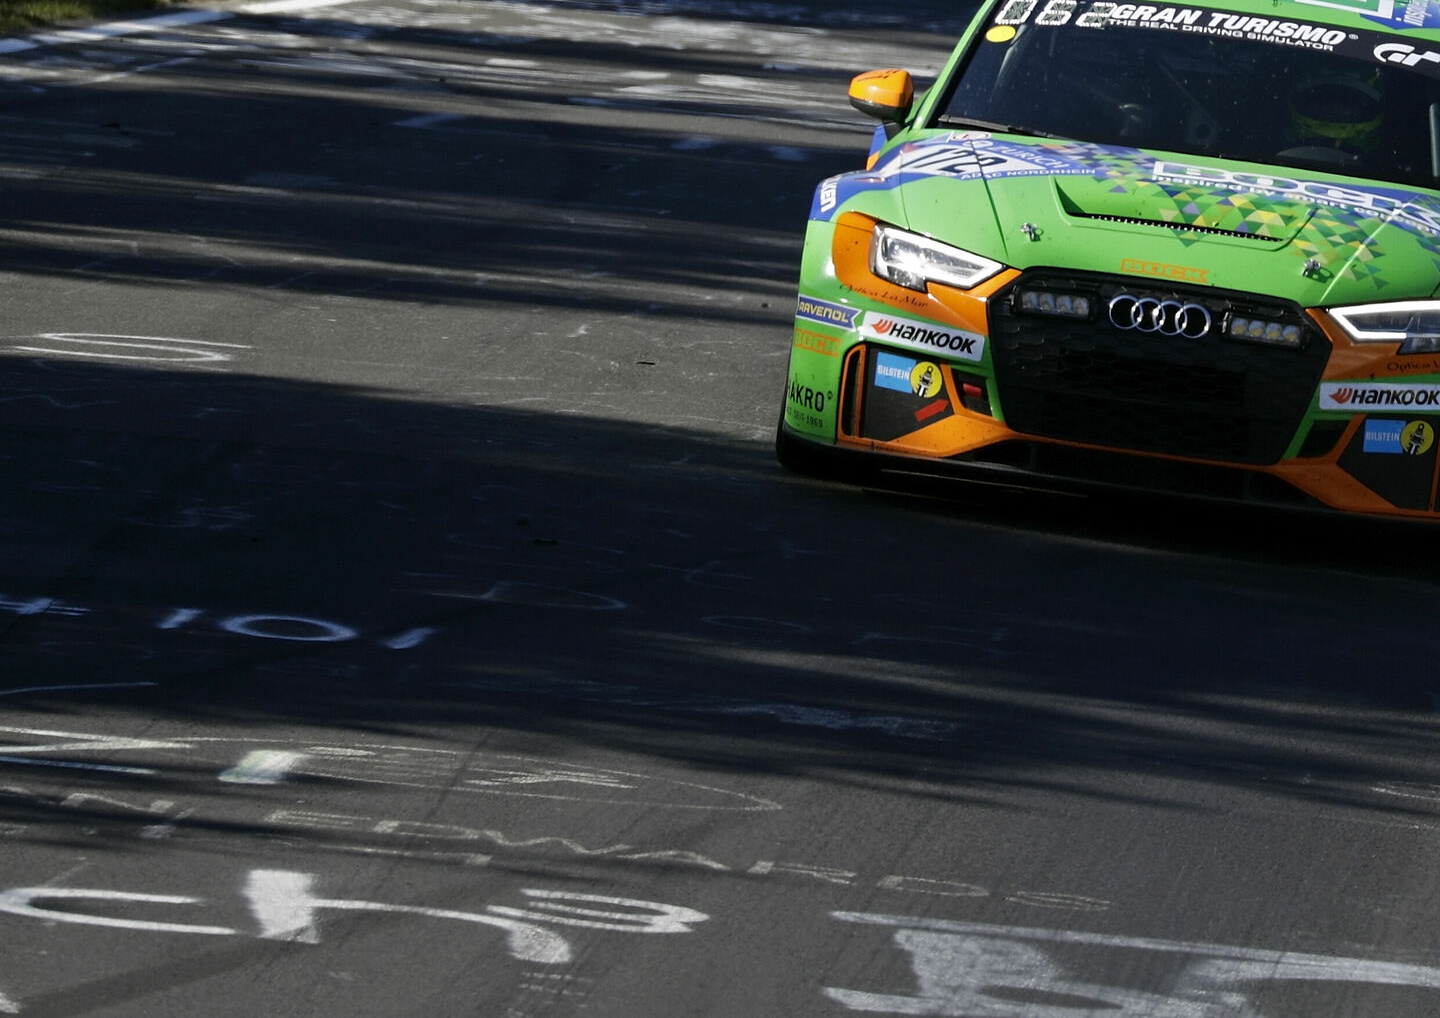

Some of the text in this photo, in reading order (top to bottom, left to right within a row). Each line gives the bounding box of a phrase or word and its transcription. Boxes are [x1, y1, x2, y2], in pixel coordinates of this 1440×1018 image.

[1108, 18, 1334, 52] THE REAL DRIVING SIMULATOR
[1111, 3, 1346, 45] GRAN TURISMO
[961, 168, 1096, 180] ADAC NORDRHEIN
[1151, 175, 1242, 191] inspired
[1250, 186, 1275, 197] by
[1283, 192, 1347, 210] smart
[1121, 258, 1209, 284] BOCK
[877, 364, 911, 381] BILSTEIN
[789, 381, 825, 413] AKRO
[1365, 431, 1400, 442] BILSTEIN
